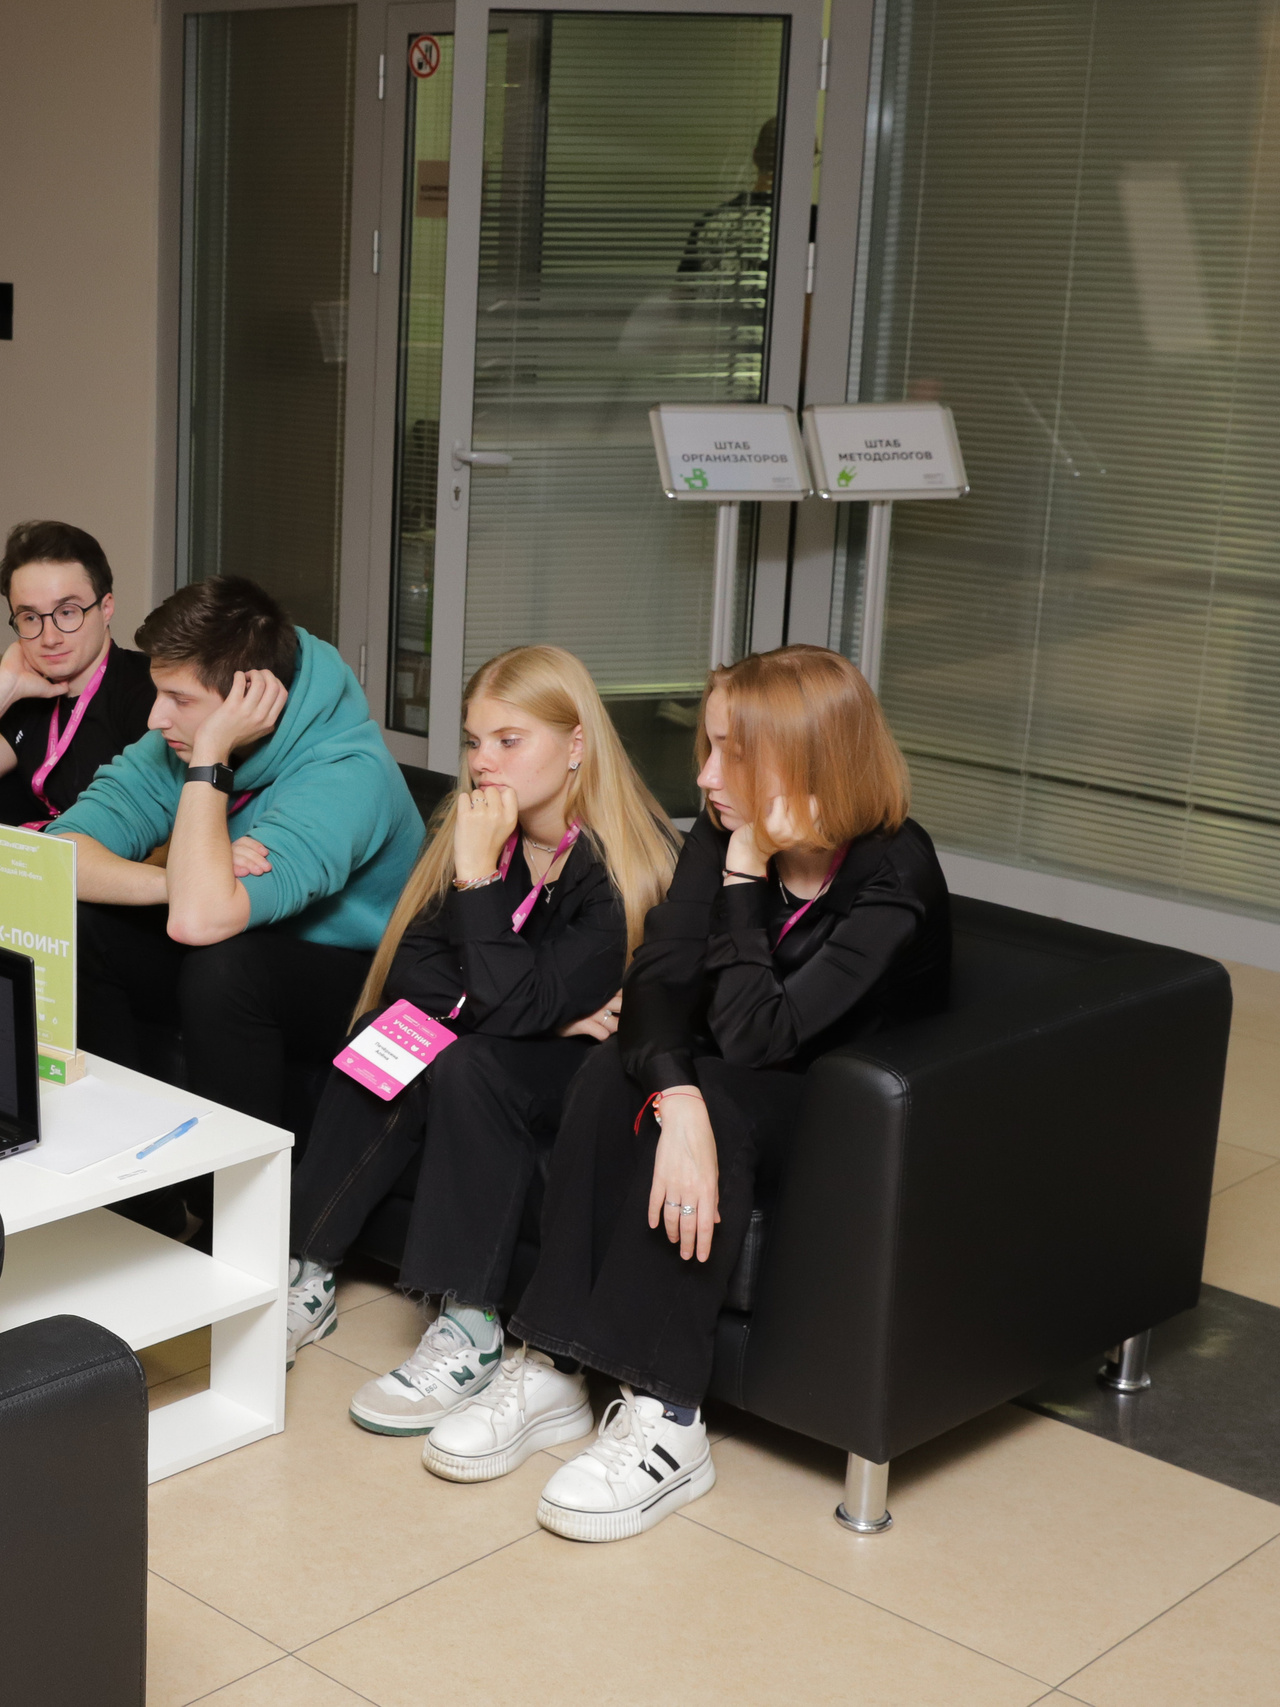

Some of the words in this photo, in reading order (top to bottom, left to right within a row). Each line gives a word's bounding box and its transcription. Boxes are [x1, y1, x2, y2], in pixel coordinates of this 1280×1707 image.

[714, 441, 750, 450] ШТАБ
[865, 438, 901, 449] ШТАБ
[682, 452, 788, 464] ОРГАНИЗАТОРОВ
[838, 451, 933, 462] МЕТОДОЛОГОВ
[393, 1019, 432, 1048] УЧАСТНИК
[424, 1383, 438, 1394] 550
